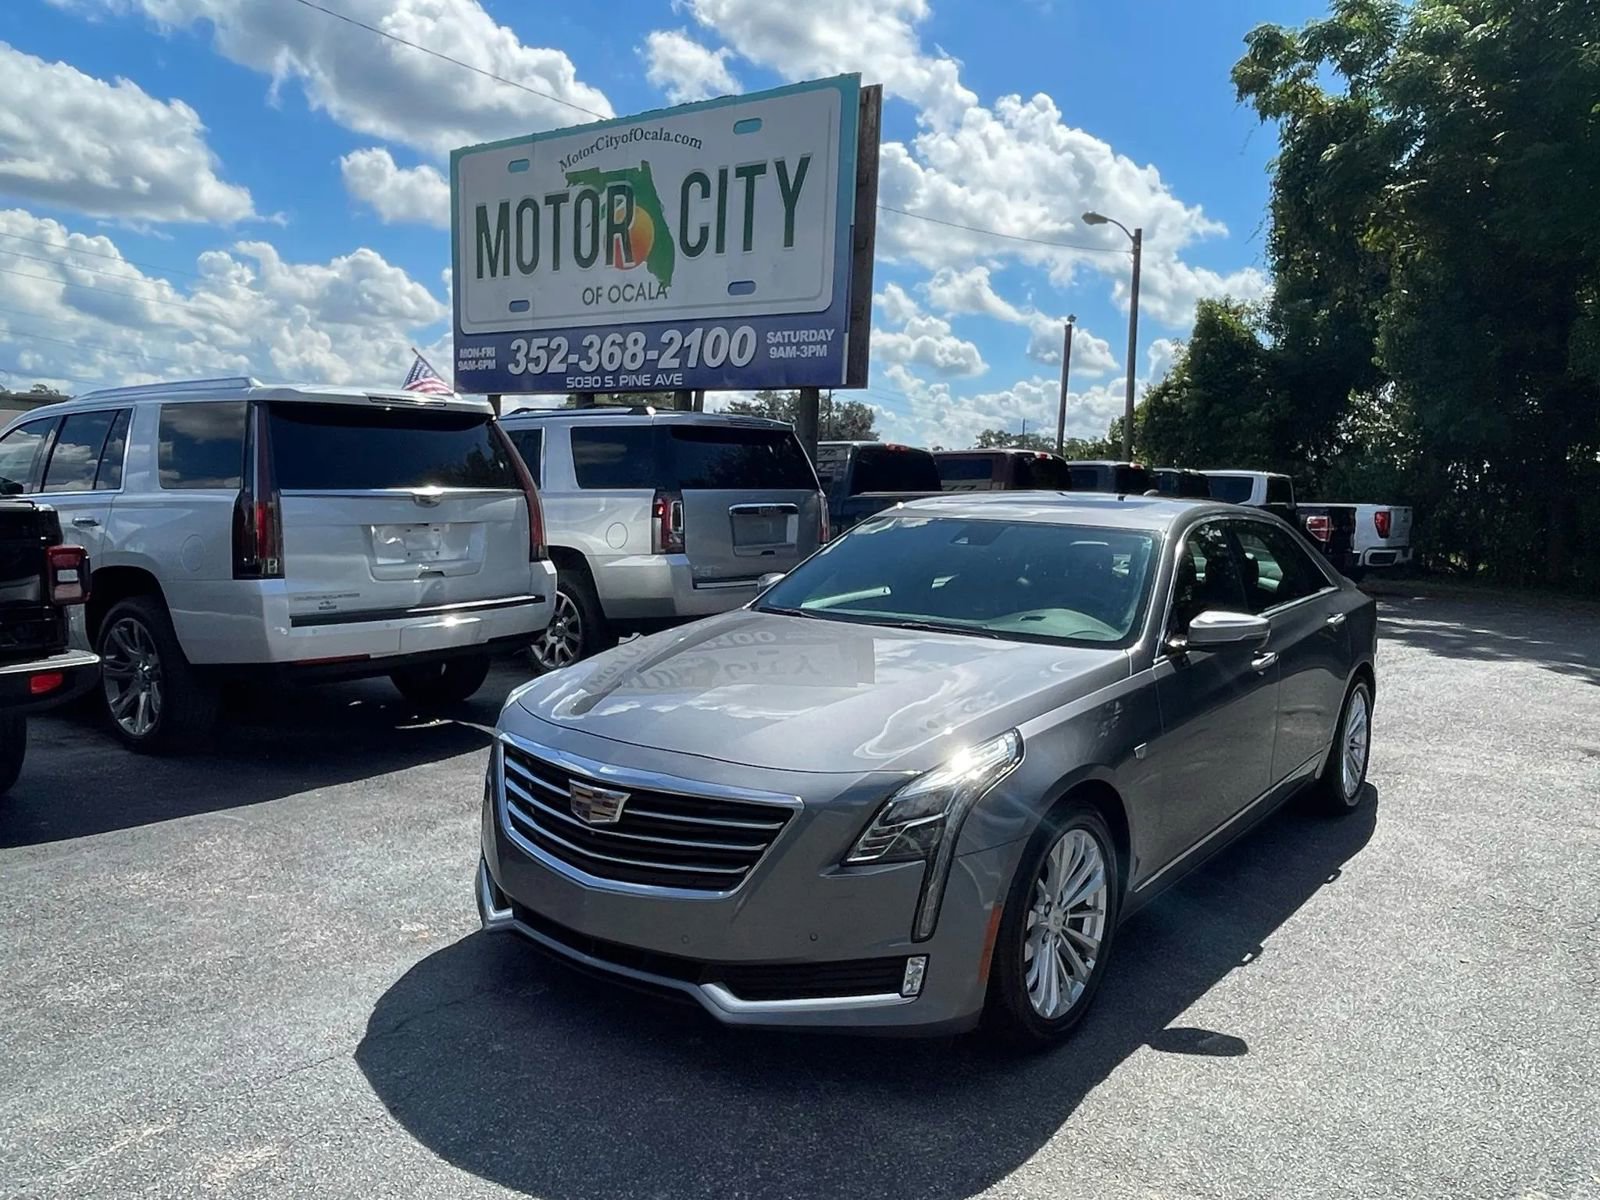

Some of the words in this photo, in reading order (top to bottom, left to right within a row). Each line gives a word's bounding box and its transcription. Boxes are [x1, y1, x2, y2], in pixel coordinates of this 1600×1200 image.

[558, 127, 702, 172] MotorCityofOcala.com
[475, 184, 635, 279] MOTOR
[679, 156, 812, 258] CITY
[582, 286, 604, 306] OF
[608, 281, 668, 304] OCALA
[766, 329, 835, 344] SATURDAY
[459, 346, 496, 359] MON-FRI
[507, 325, 758, 376] 352-368-2100
[769, 344, 828, 359] 9AM-3PM
[566, 376, 602, 389] 5030
[604, 375, 617, 388] S.
[619, 374, 651, 387] PINE
[654, 373, 683, 386] AVE
